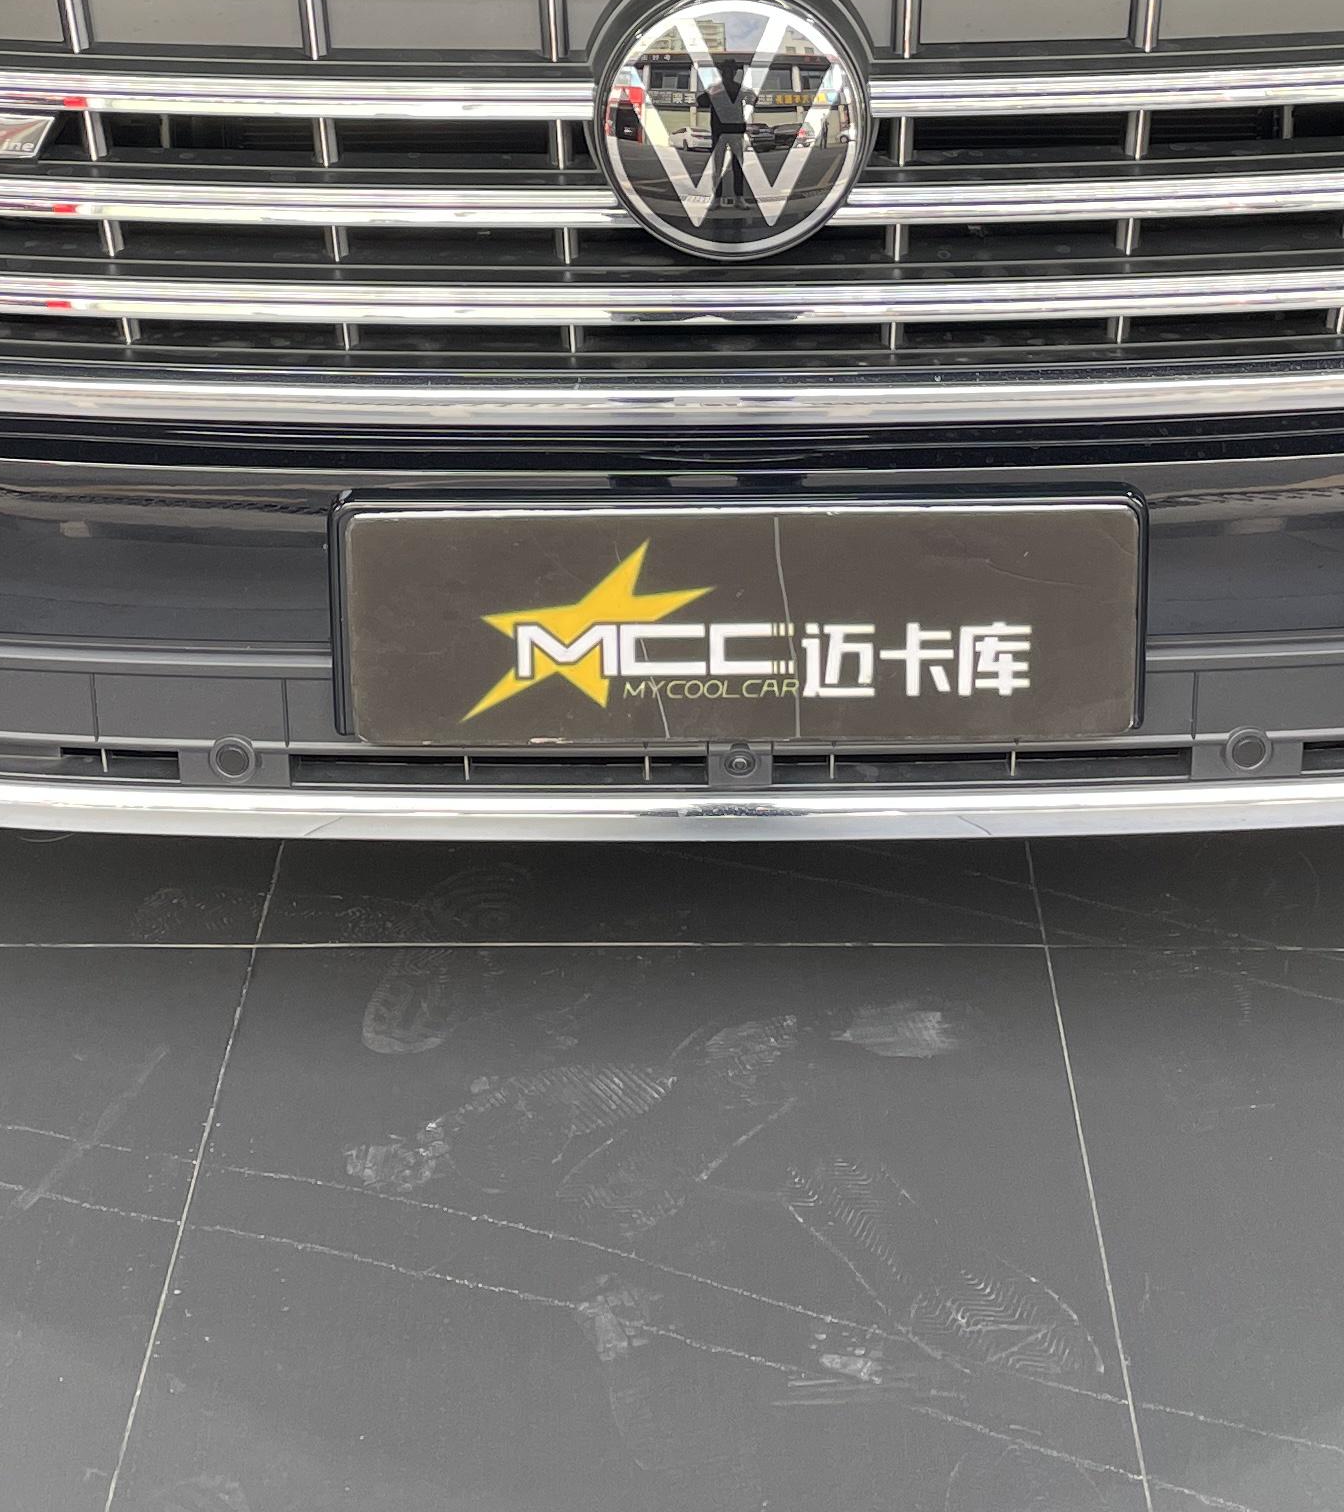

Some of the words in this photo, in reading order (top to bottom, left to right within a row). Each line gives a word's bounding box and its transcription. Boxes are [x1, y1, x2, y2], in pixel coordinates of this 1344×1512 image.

[513, 622, 794, 680] MCC
[802, 622, 1033, 698] 迈卡库
